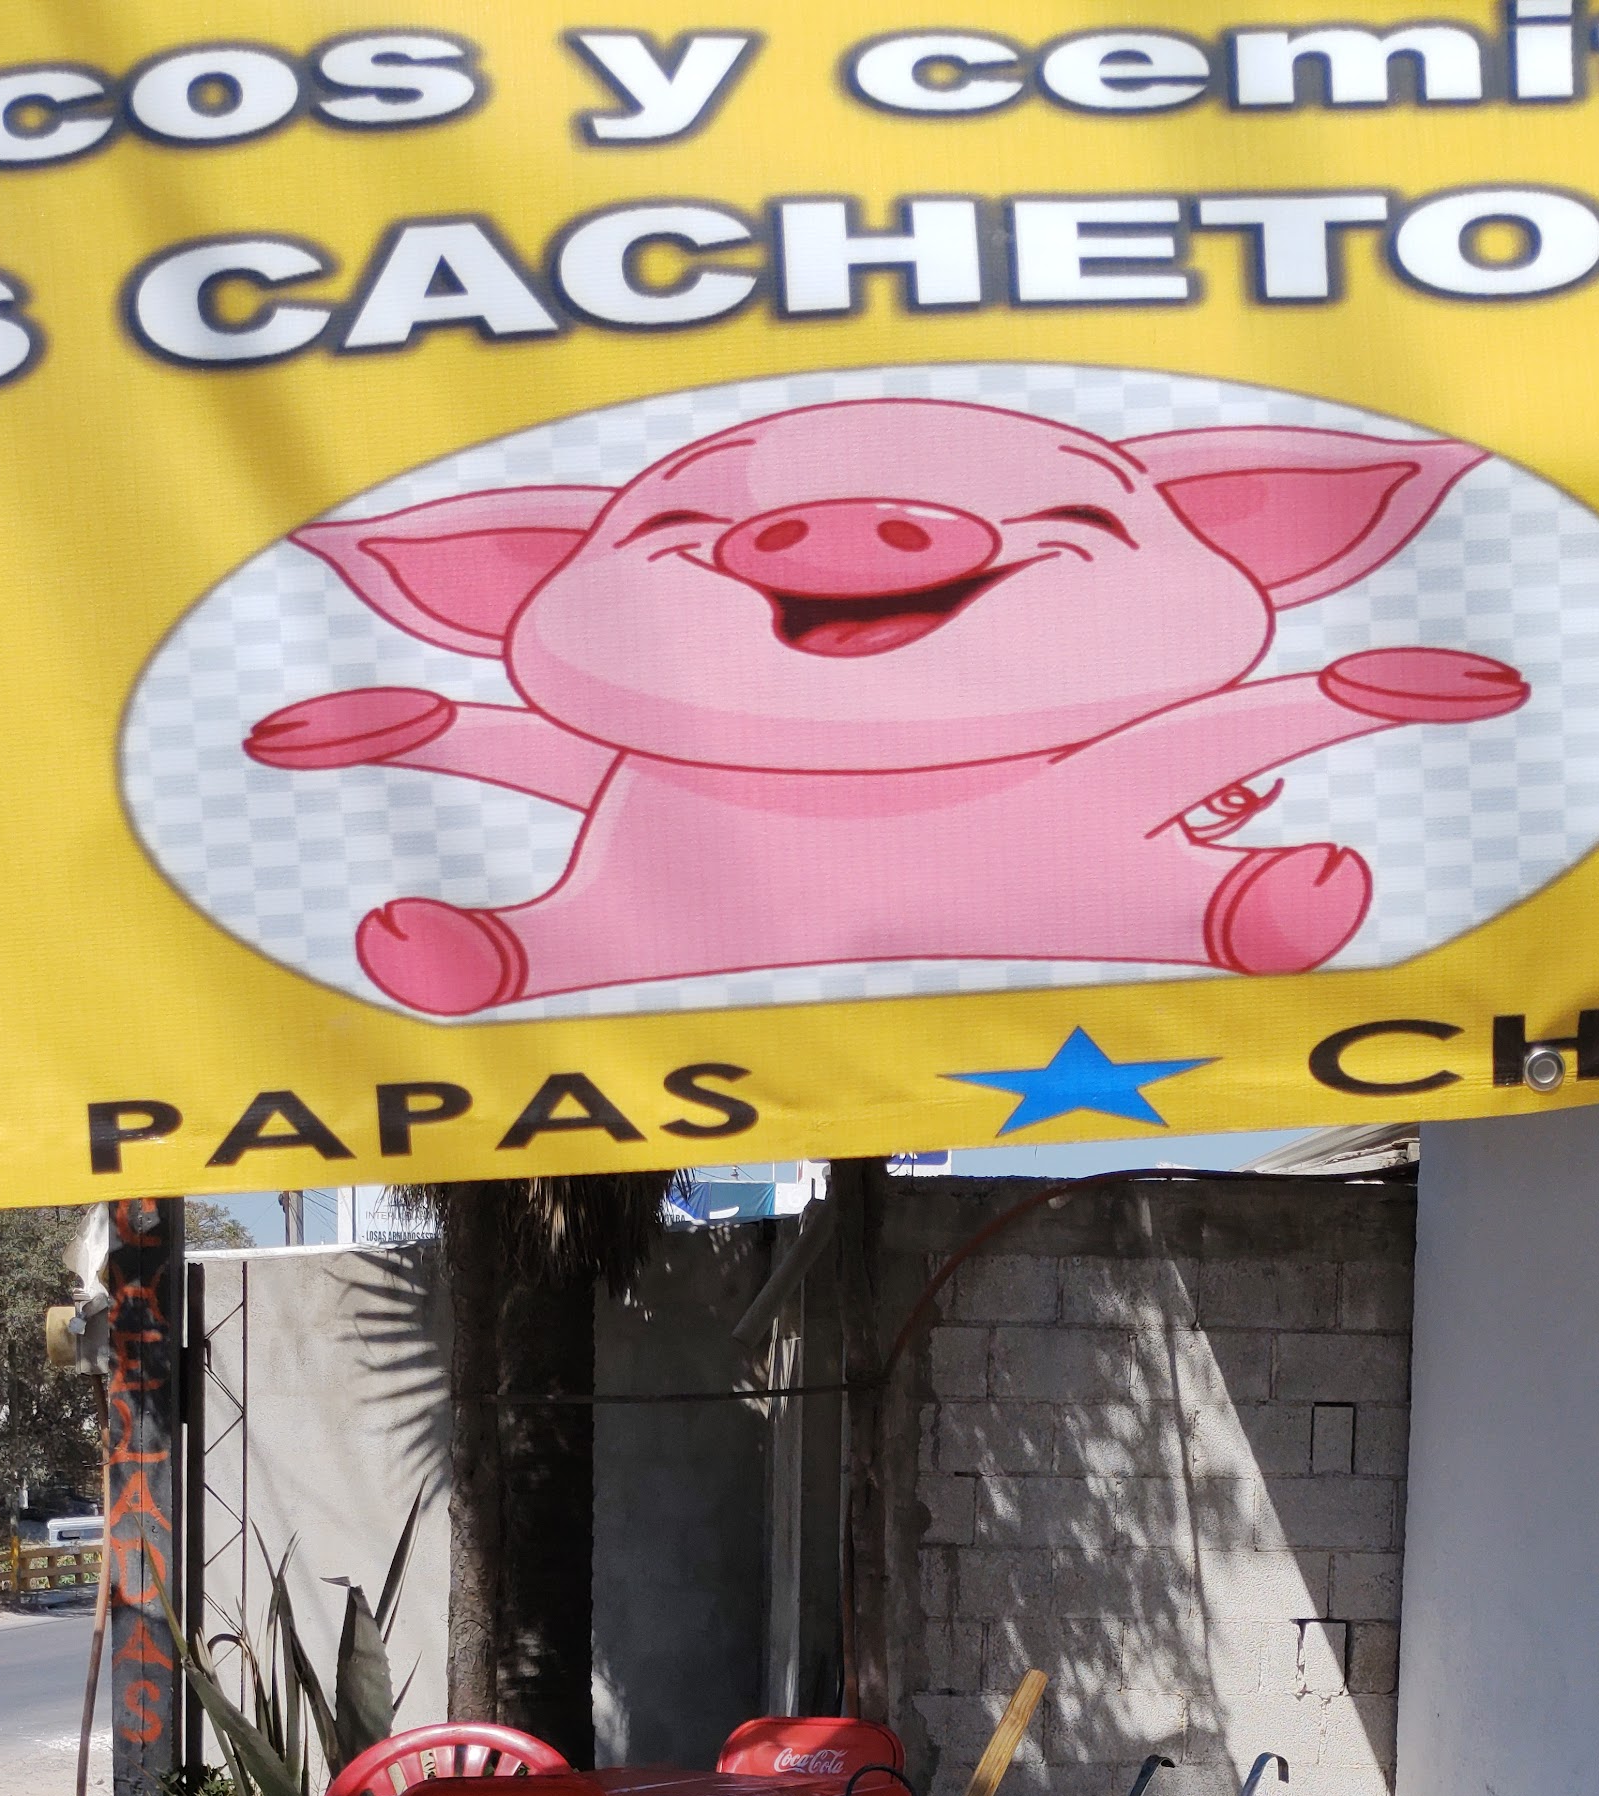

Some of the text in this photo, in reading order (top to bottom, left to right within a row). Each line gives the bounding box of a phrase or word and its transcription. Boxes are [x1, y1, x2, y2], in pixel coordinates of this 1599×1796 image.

[568, 27, 762, 146] y
[88, 1062, 759, 1175] PAPAS
[772, 1747, 849, 1775] Coca-Cola
